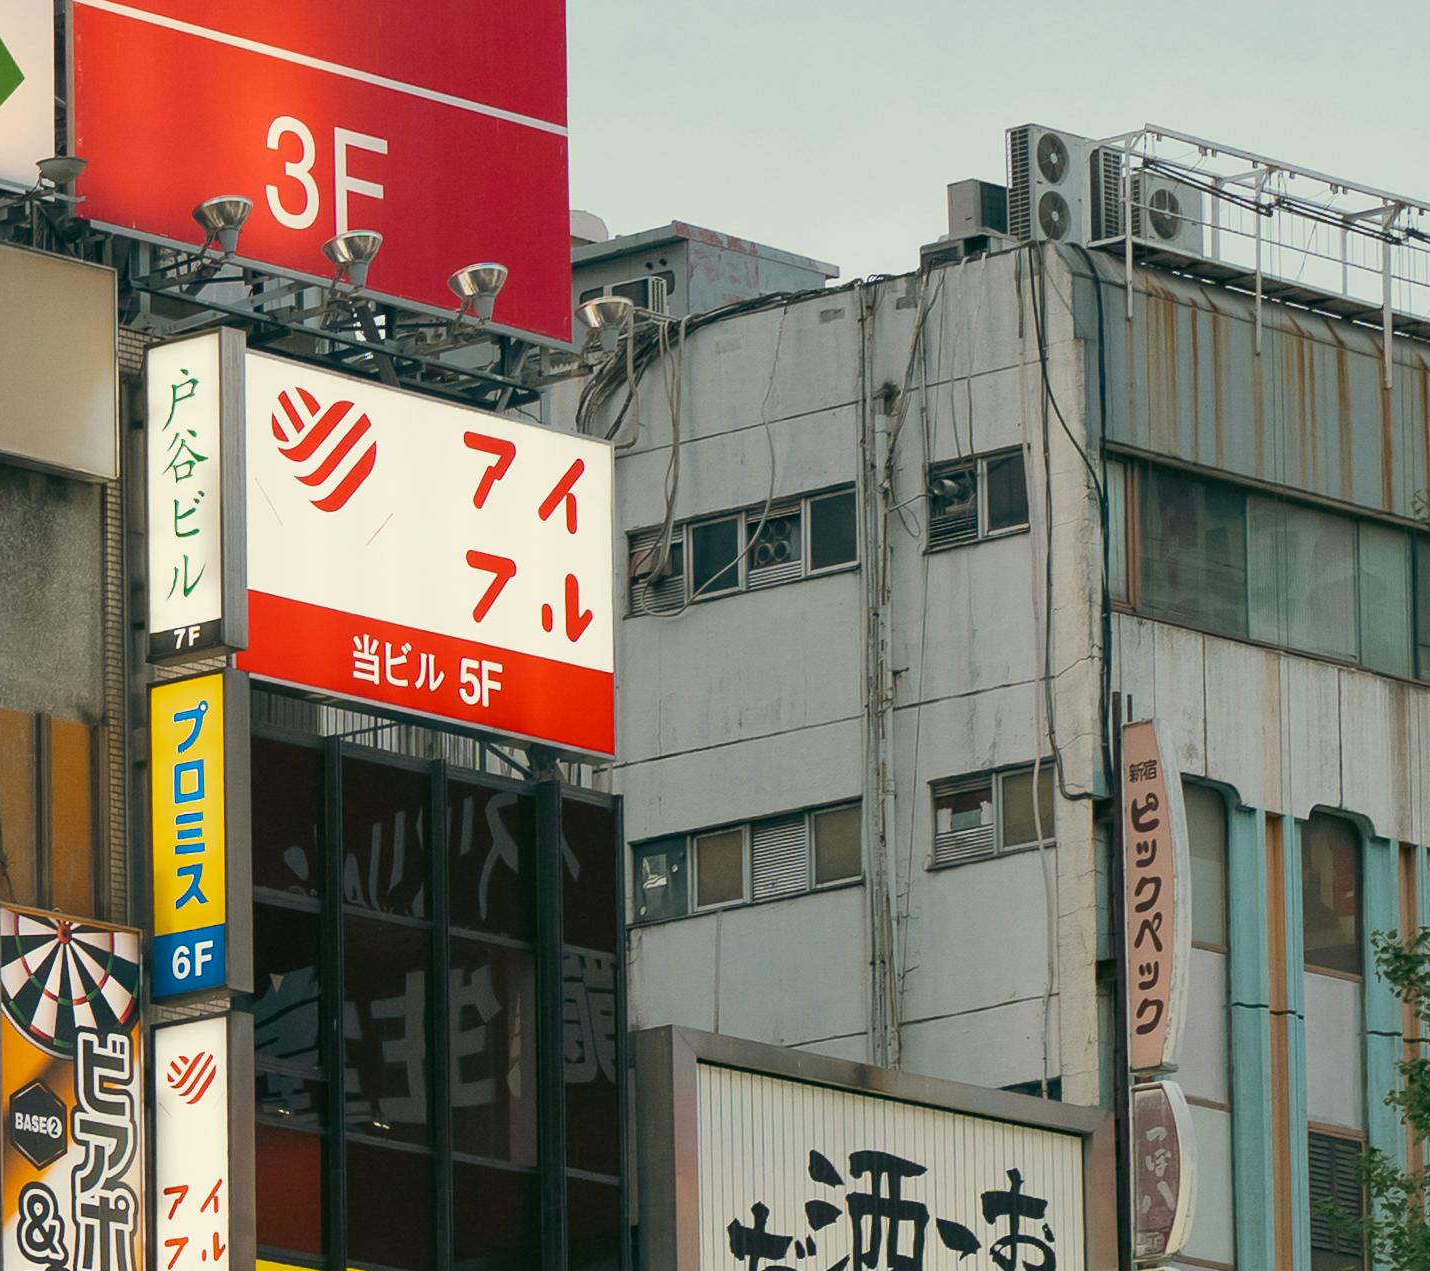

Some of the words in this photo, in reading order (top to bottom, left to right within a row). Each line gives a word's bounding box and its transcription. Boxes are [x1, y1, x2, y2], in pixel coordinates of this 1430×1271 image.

[265, 114, 389, 235] 3F
[163, 368, 209, 602] 戸谷ビル
[173, 623, 201, 650] 7F
[351, 632, 446, 693] 当ビル
[459, 653, 505, 709] 5F
[172, 700, 210, 911] プロミス
[1128, 758, 1158, 784] 新宿
[171, 939, 214, 982] 6F
